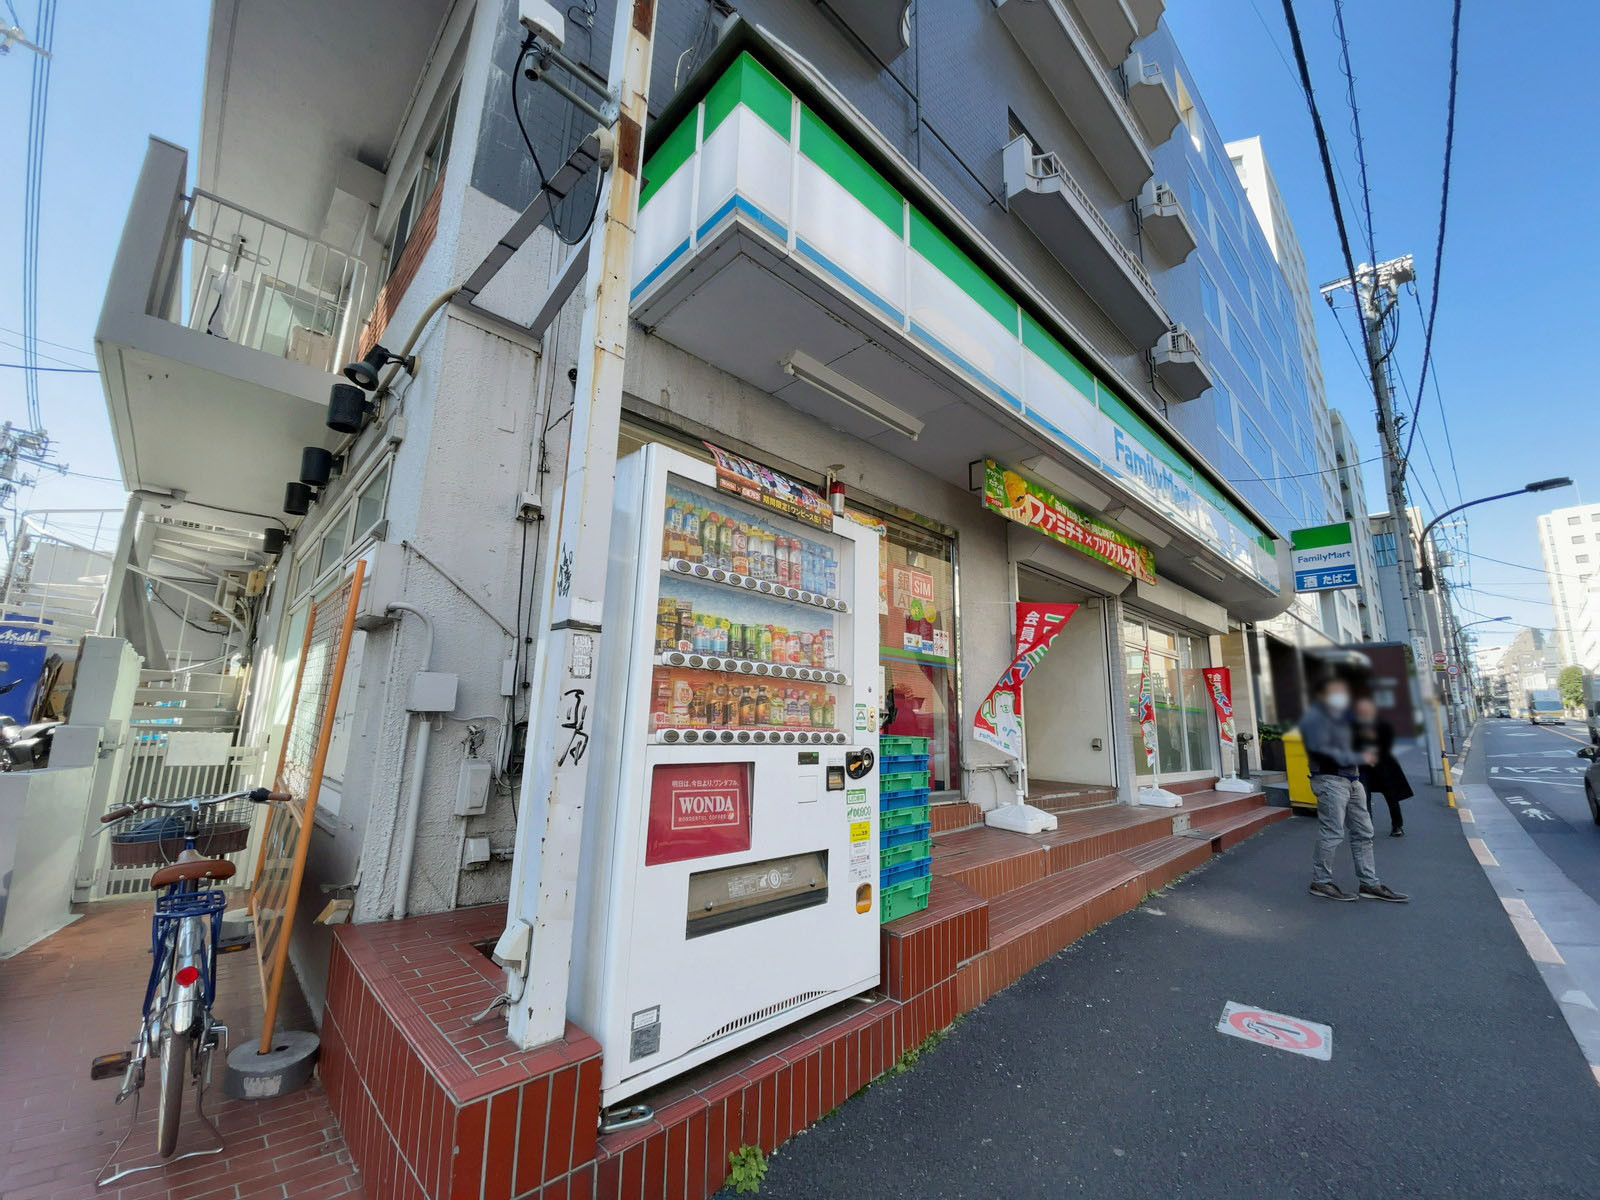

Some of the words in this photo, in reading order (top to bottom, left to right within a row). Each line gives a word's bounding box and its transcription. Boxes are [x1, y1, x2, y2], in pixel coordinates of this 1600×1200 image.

[1113, 426, 1192, 502] FamilyMart
[1297, 550, 1351, 563] FamilyMart
[914, 580, 931, 596] SIM
[1303, 576, 1318, 588] 酒
[1322, 573, 1353, 585] たばこ
[0, 629, 38, 641] Asahi
[678, 795, 735, 814] WONDA
